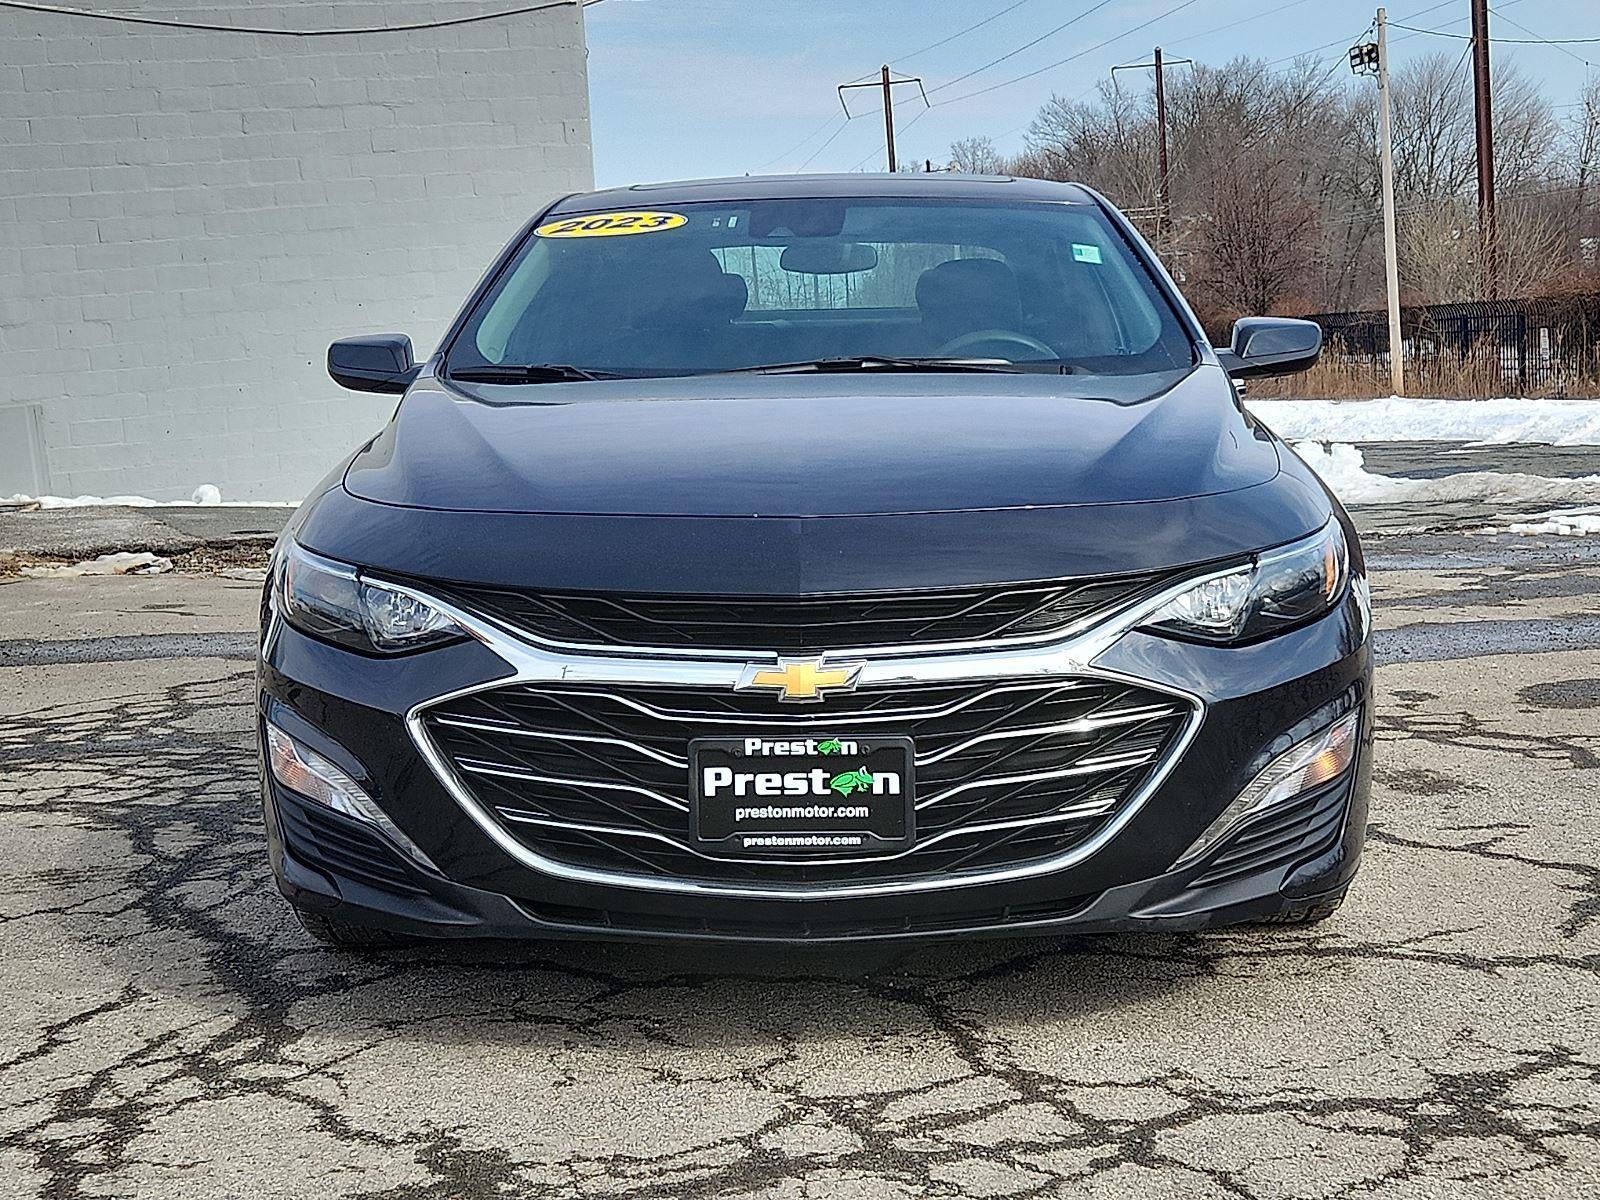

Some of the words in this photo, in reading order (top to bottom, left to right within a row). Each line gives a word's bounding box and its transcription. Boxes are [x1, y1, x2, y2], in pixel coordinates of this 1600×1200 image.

[549, 216, 672, 234] 2023
[735, 805, 869, 821] prestonmotor.com
[743, 835, 862, 847] prestonmotor.com
